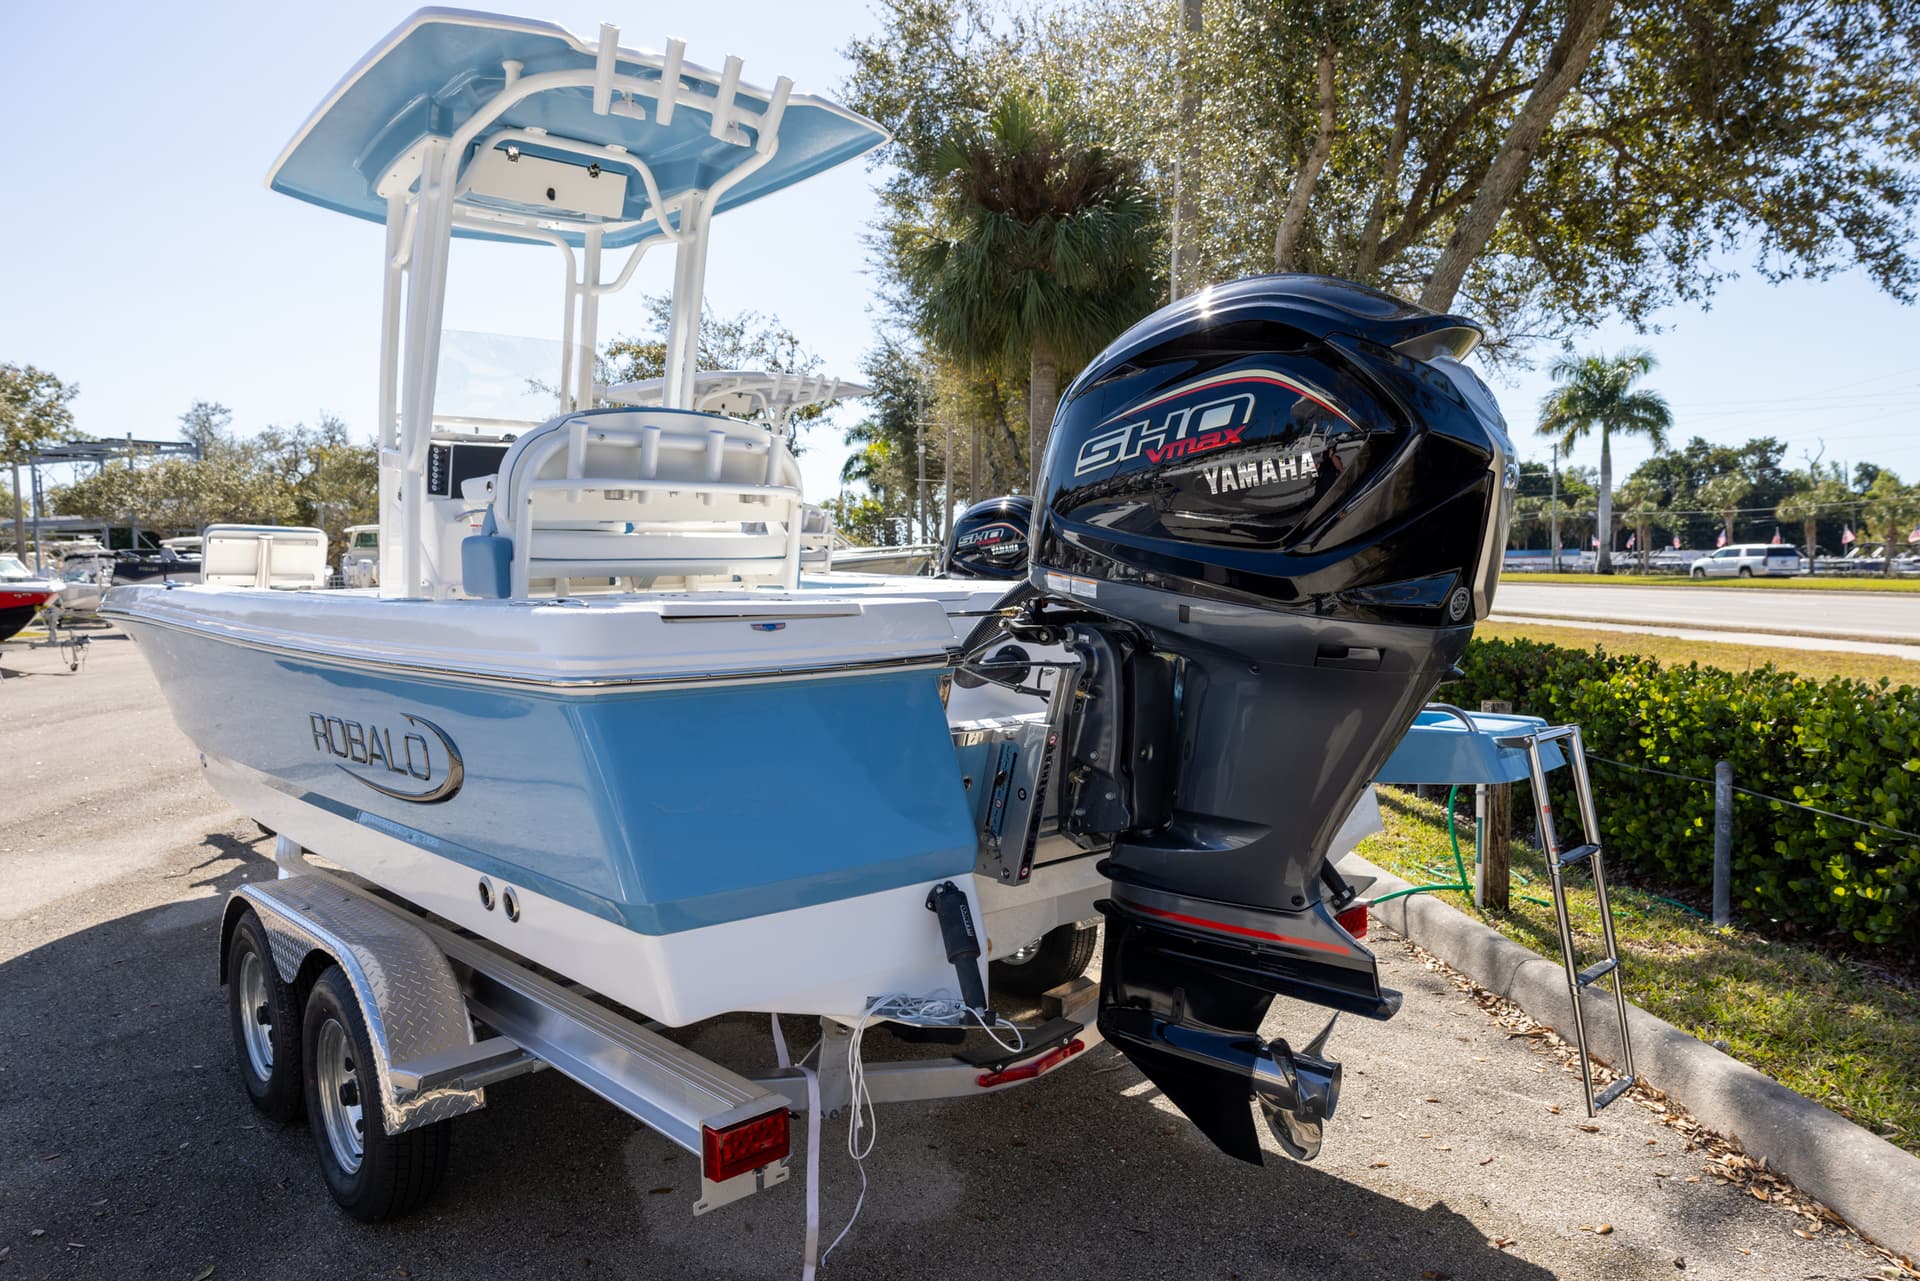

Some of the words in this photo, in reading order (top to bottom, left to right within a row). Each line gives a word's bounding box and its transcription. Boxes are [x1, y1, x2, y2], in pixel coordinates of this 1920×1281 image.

[1074, 393, 1256, 478] SHO
[1202, 450, 1320, 495] YAMAHA
[957, 528, 1005, 548] SHO
[309, 711, 431, 781] ROBALO
